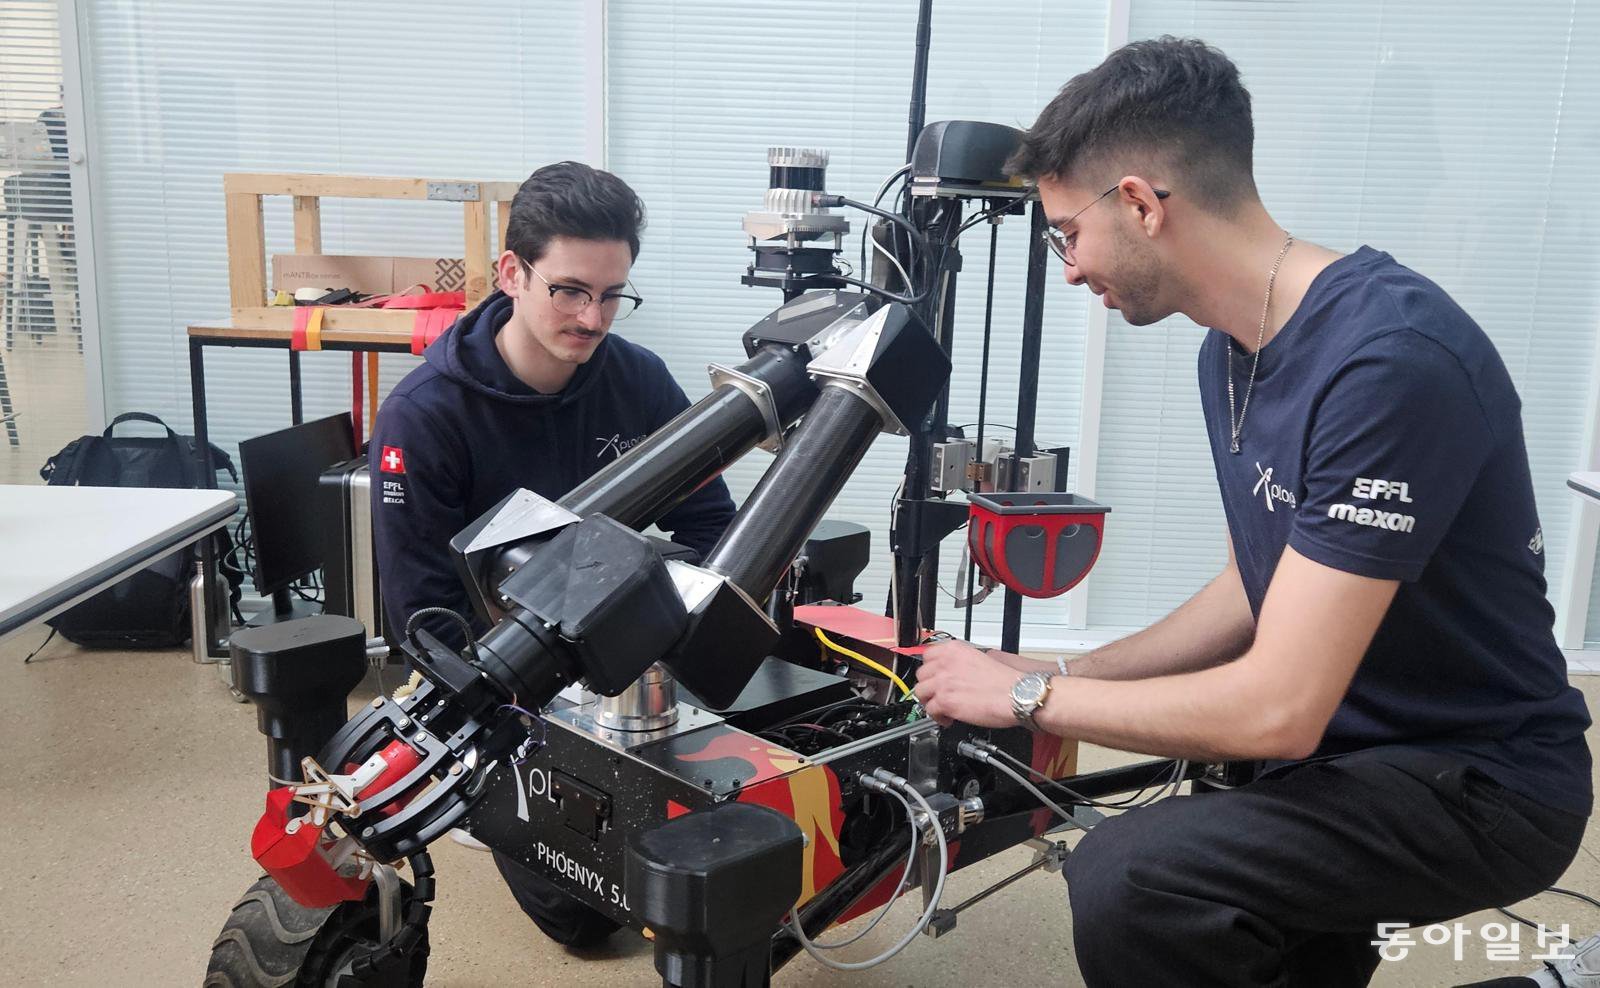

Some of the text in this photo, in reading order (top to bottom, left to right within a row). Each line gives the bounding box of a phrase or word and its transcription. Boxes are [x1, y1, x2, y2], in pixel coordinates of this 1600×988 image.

[383, 481, 404, 491] EPFL
[1352, 477, 1413, 504] EPFL
[1327, 503, 1416, 534] maxon
[537, 841, 604, 897] PHOENYX
